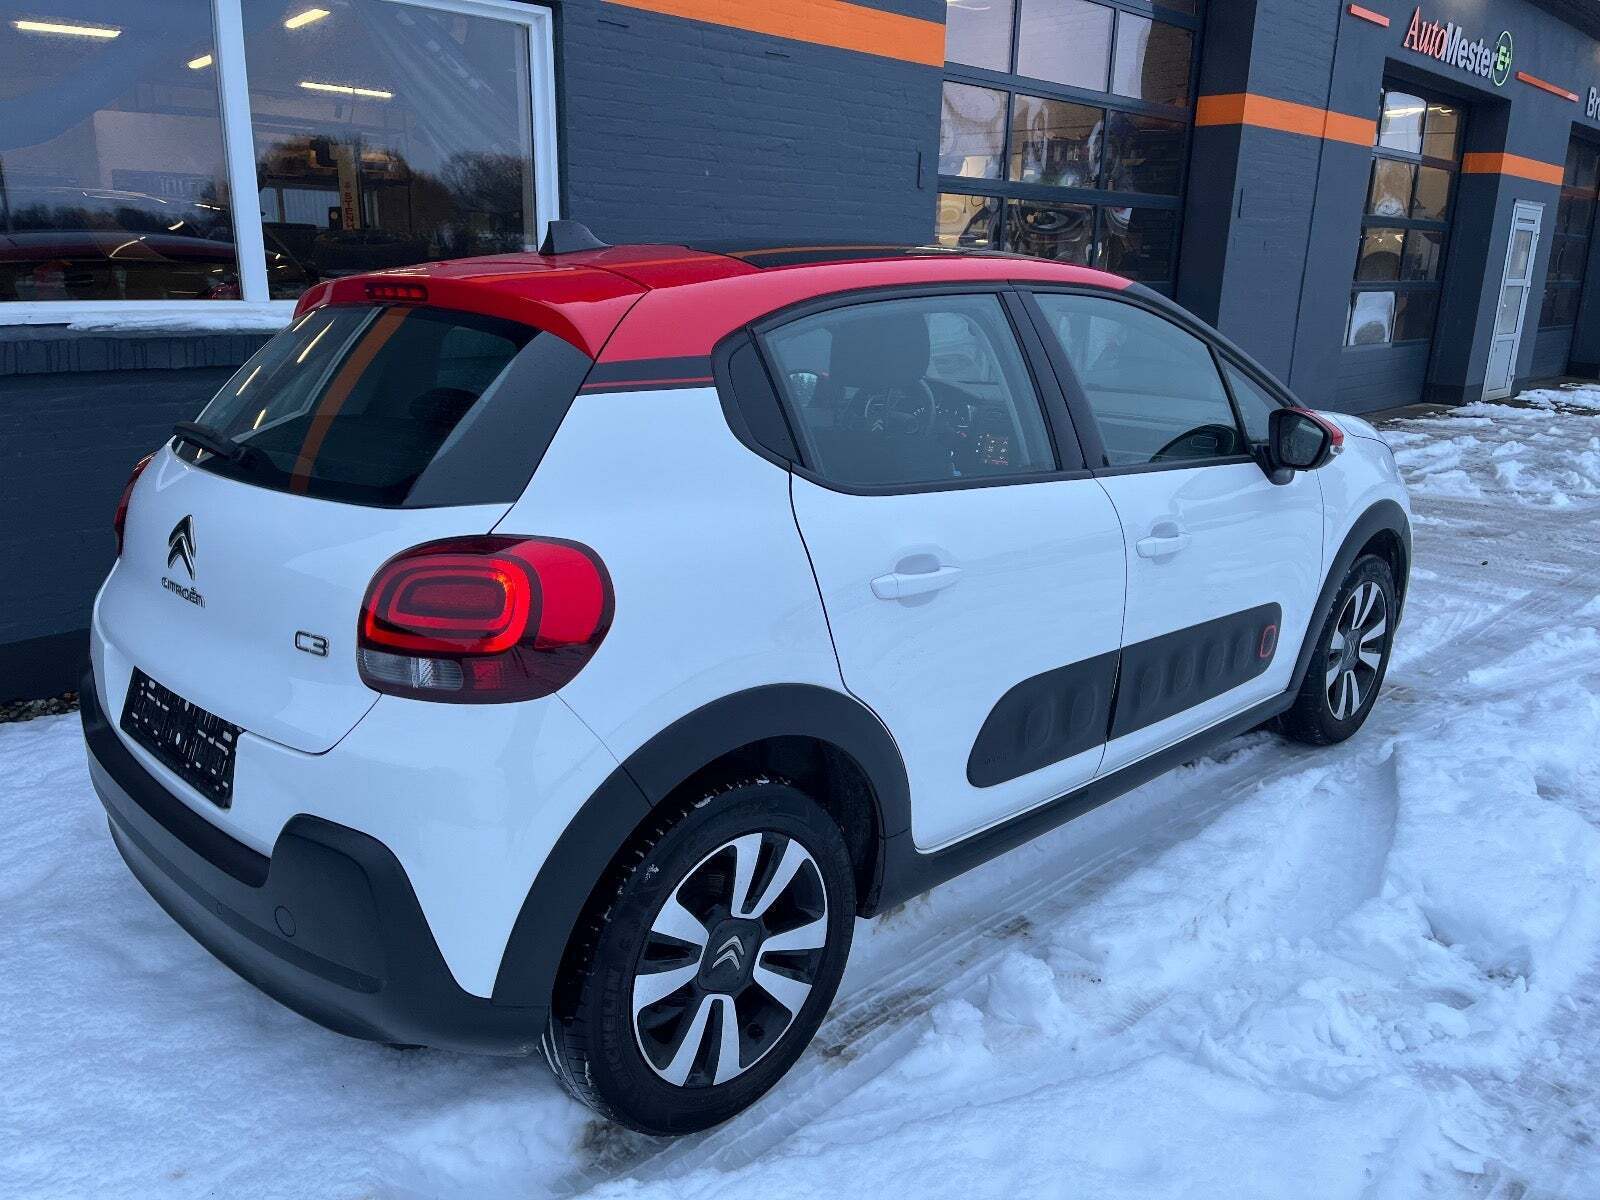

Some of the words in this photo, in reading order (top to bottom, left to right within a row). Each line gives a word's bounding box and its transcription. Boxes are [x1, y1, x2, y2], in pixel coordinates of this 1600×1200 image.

[1403, 6, 1498, 79] AutoMester
[1586, 86, 1600, 121] Br
[294, 630, 329, 657] C3
